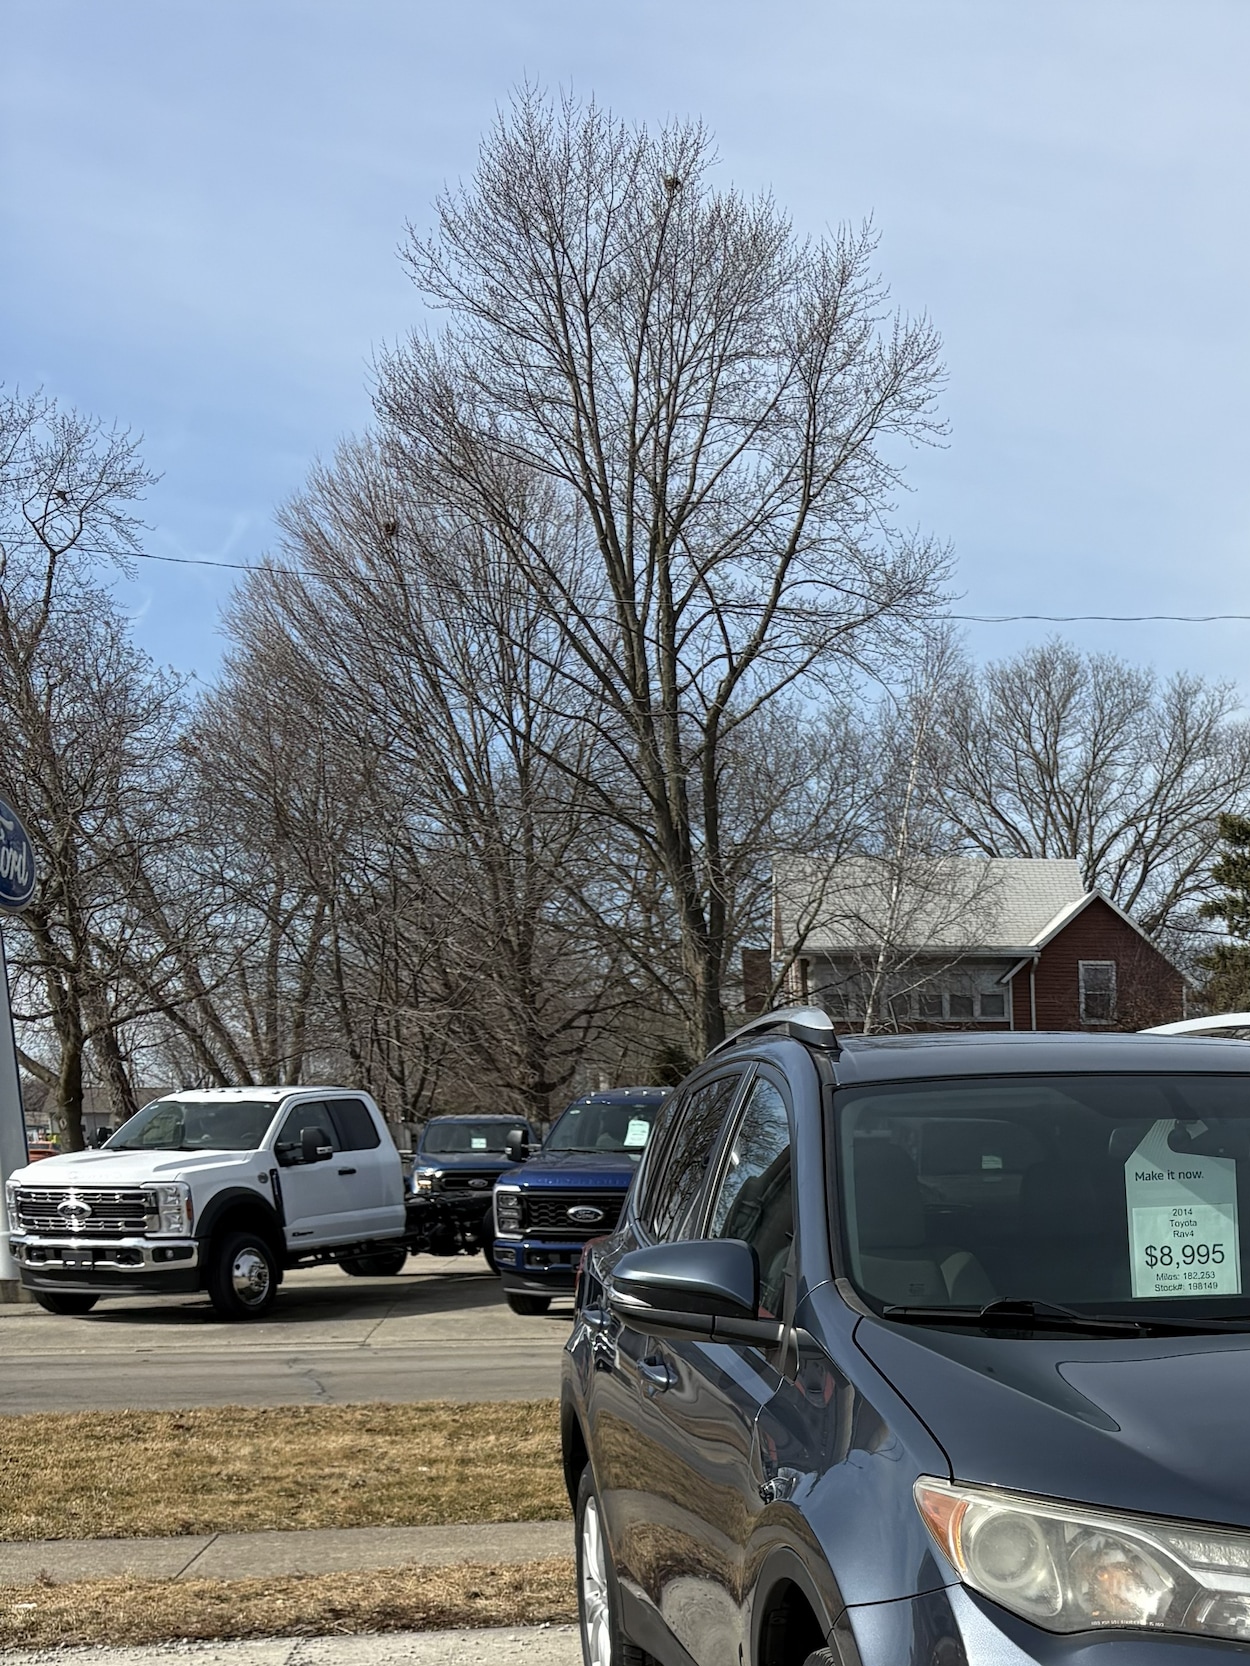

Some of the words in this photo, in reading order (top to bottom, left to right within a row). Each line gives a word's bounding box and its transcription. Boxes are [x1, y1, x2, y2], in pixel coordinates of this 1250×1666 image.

[0, 816, 28, 886] ord
[1135, 1171, 1164, 1181] Make
[1167, 1170, 1175, 1180] it
[1178, 1170, 1204, 1180] now.
[1172, 1208, 1193, 1217] 2014
[1169, 1219, 1198, 1228] Toyota
[1173, 1230, 1194, 1238] Rav4
[1144, 1243, 1225, 1269] $8,995
[1156, 1272, 1180, 1281] Miles:
[1154, 1284, 1185, 1292] Stock#:
